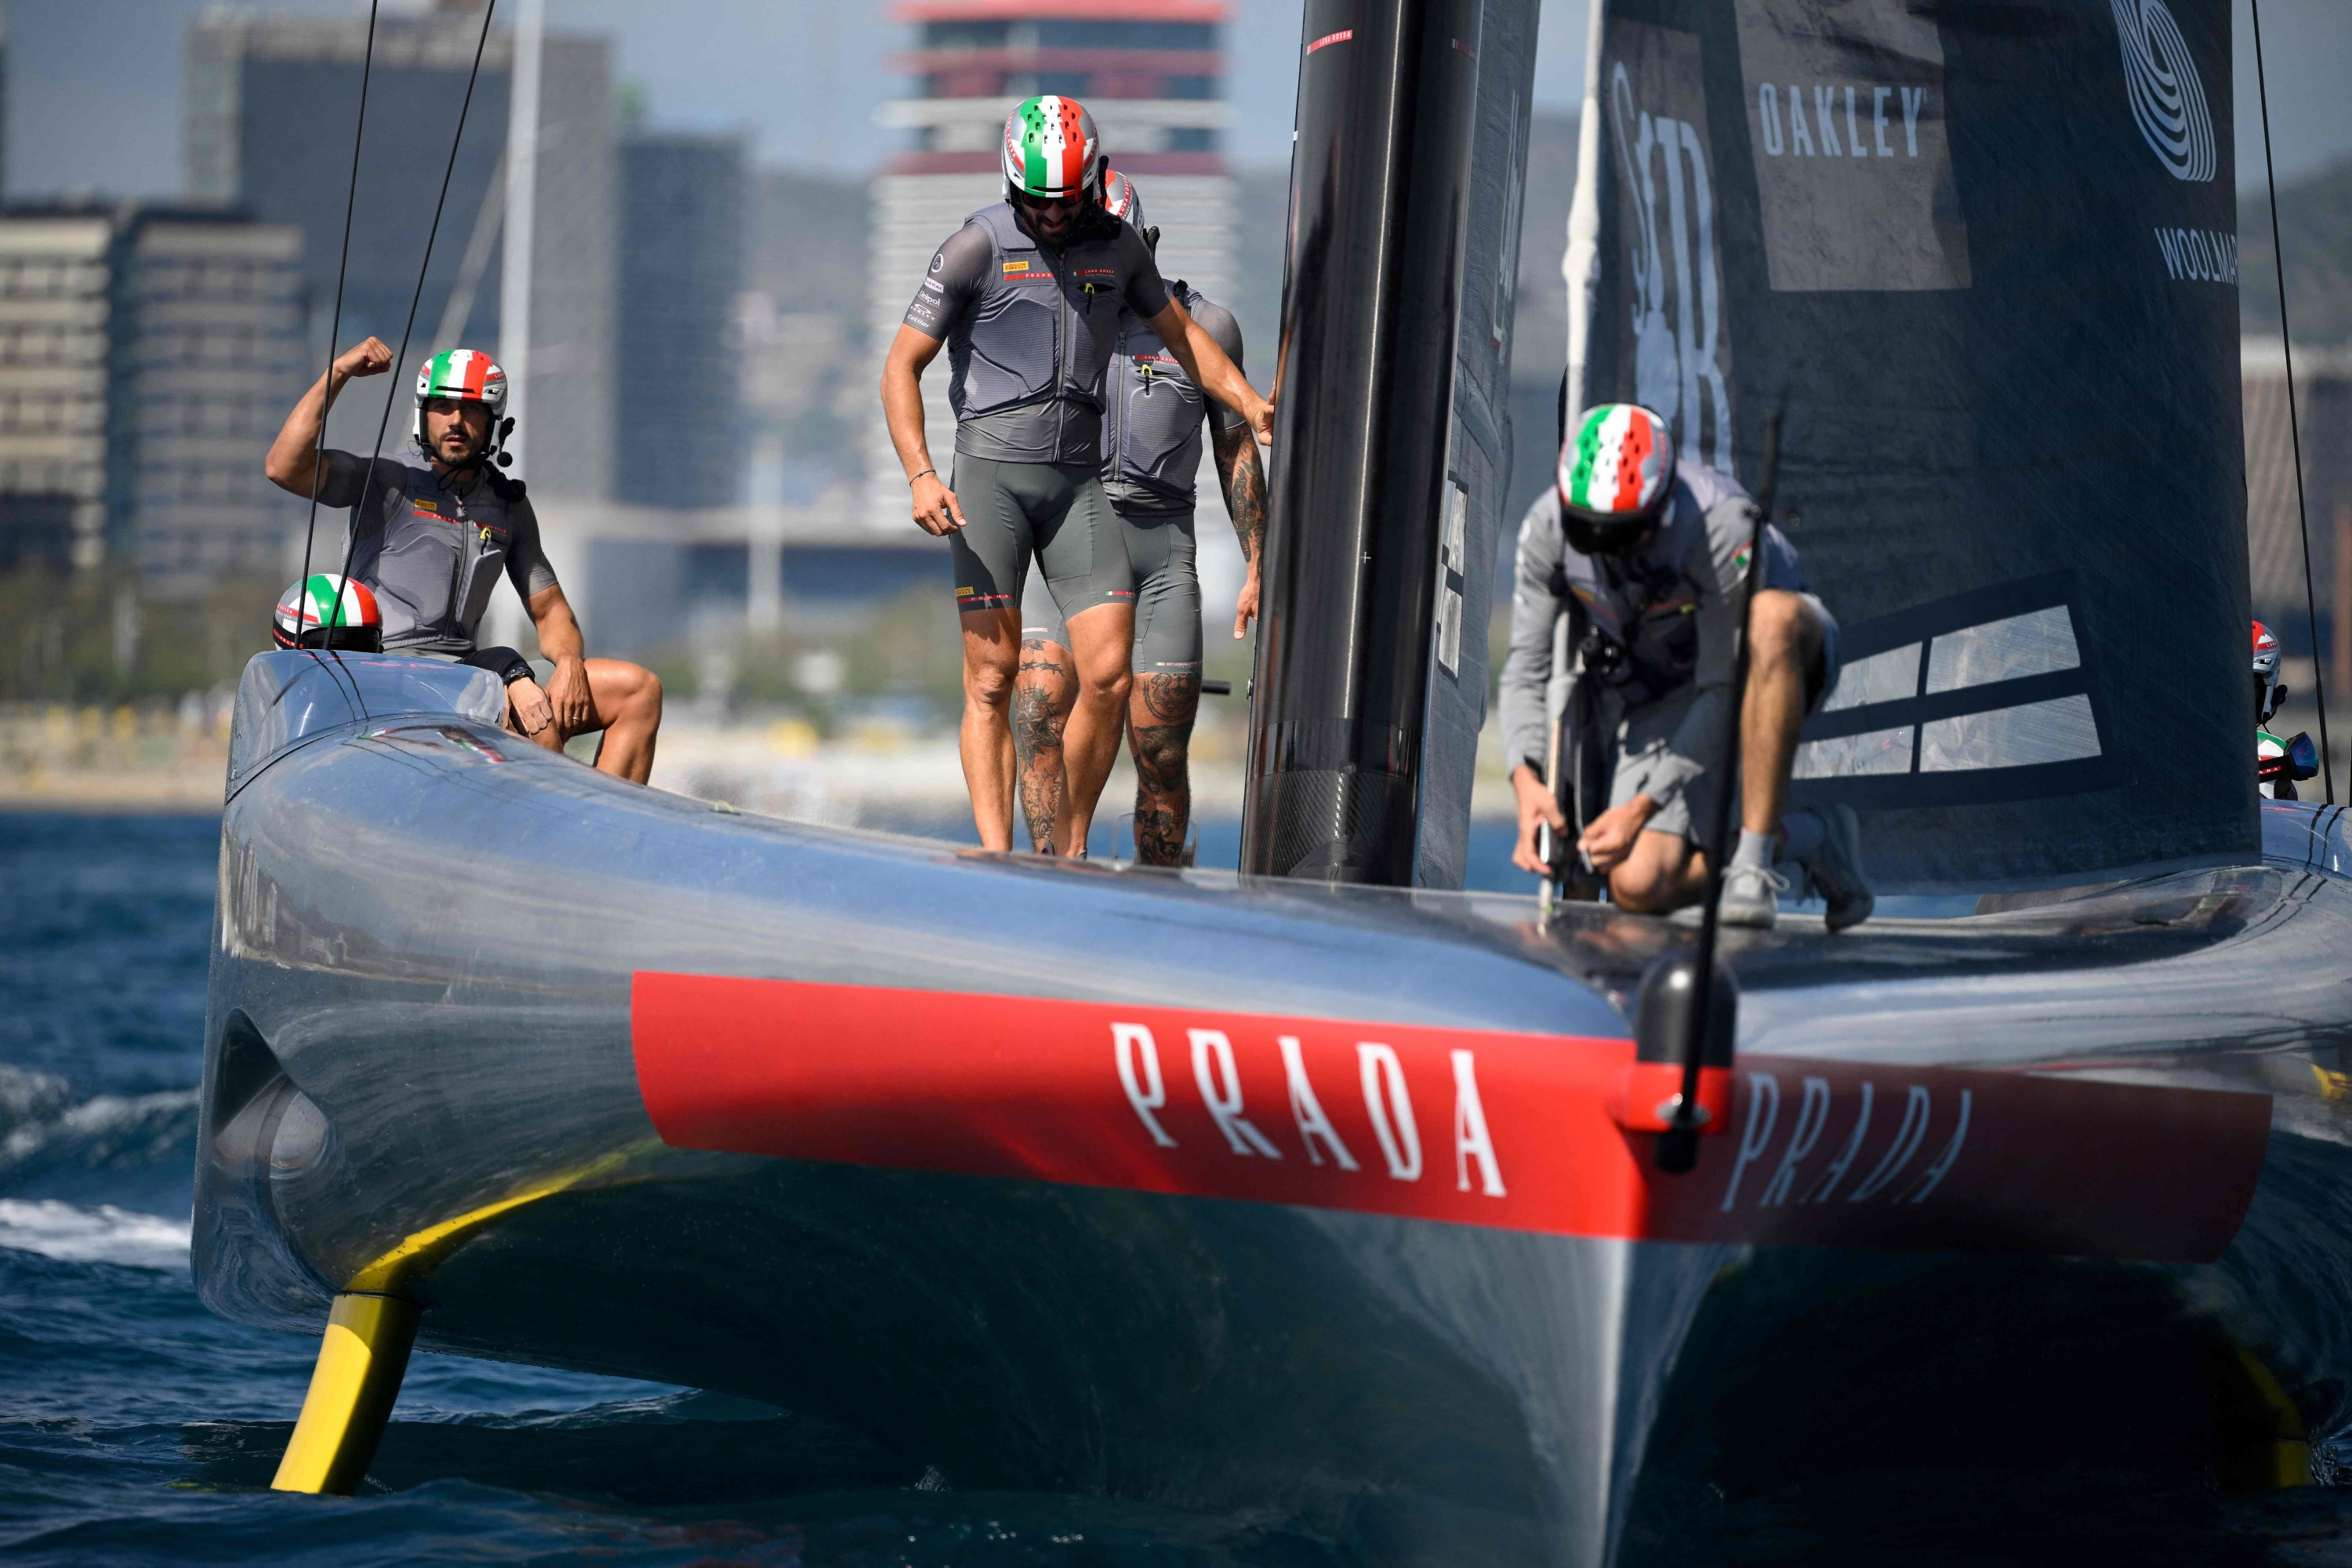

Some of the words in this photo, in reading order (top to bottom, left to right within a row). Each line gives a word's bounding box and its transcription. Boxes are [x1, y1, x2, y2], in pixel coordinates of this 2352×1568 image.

[1319, 36, 1330, 45] LUNA
[1332, 31, 1351, 41] ROSSA
[1759, 82, 1919, 157] OAKLEY
[1118, 198, 1129, 216] LUNA
[1004, 262, 1026, 270] PIRELLI
[919, 290, 941, 306] Unipol
[433, 514, 457, 523] PRADA
[280, 636, 295, 646] PRAD
[1110, 1022, 1507, 1198] PRADA
[1721, 1073, 1973, 1212] PRADA
